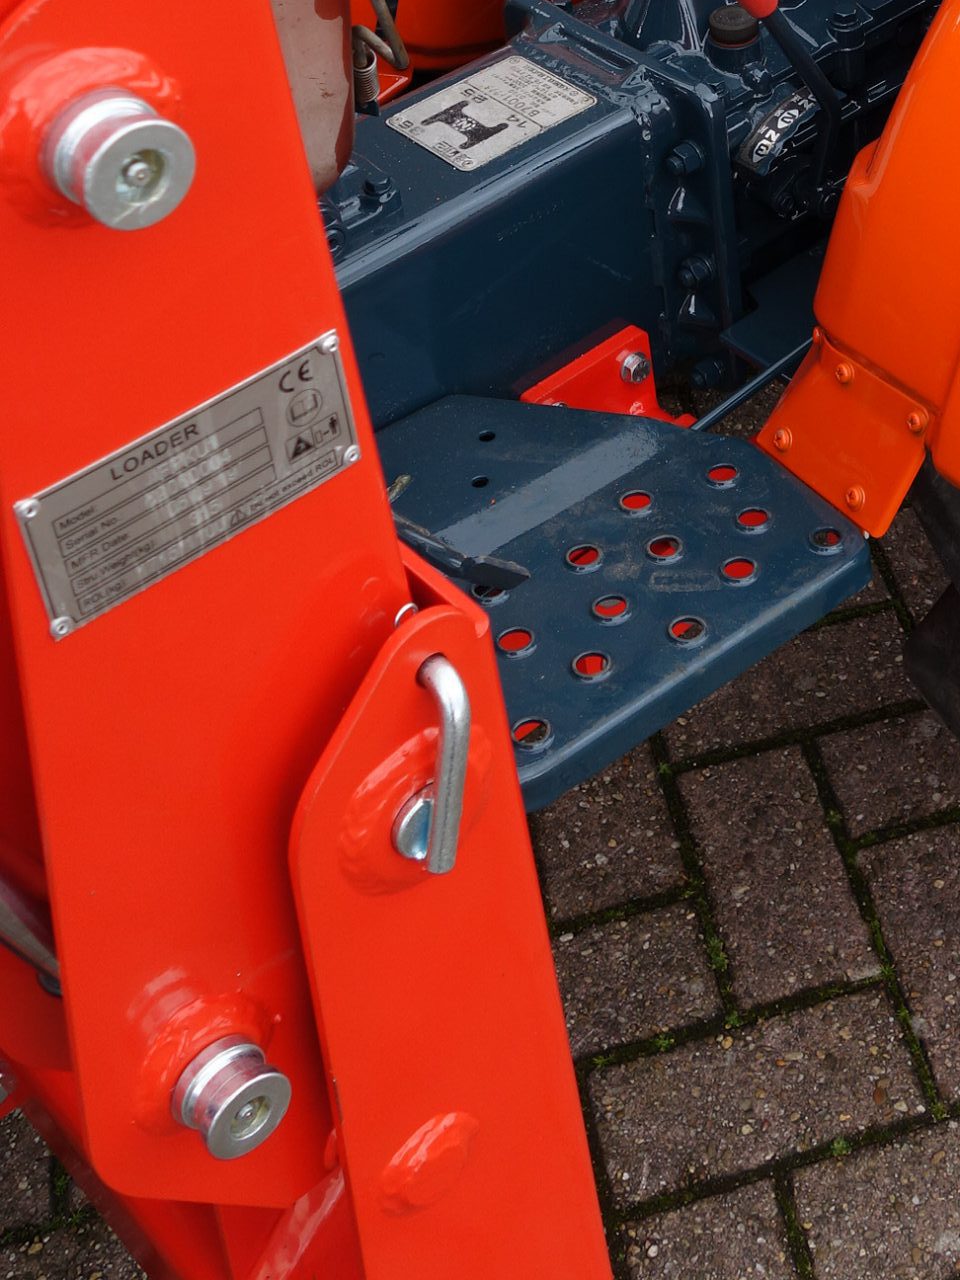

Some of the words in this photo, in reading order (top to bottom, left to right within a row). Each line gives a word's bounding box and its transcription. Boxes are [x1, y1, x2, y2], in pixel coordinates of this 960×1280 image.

[506, 114, 528, 128] 14
[277, 359, 314, 393] CE
[109, 422, 201, 481] LOADER
[315, 457, 334, 473] ROL
